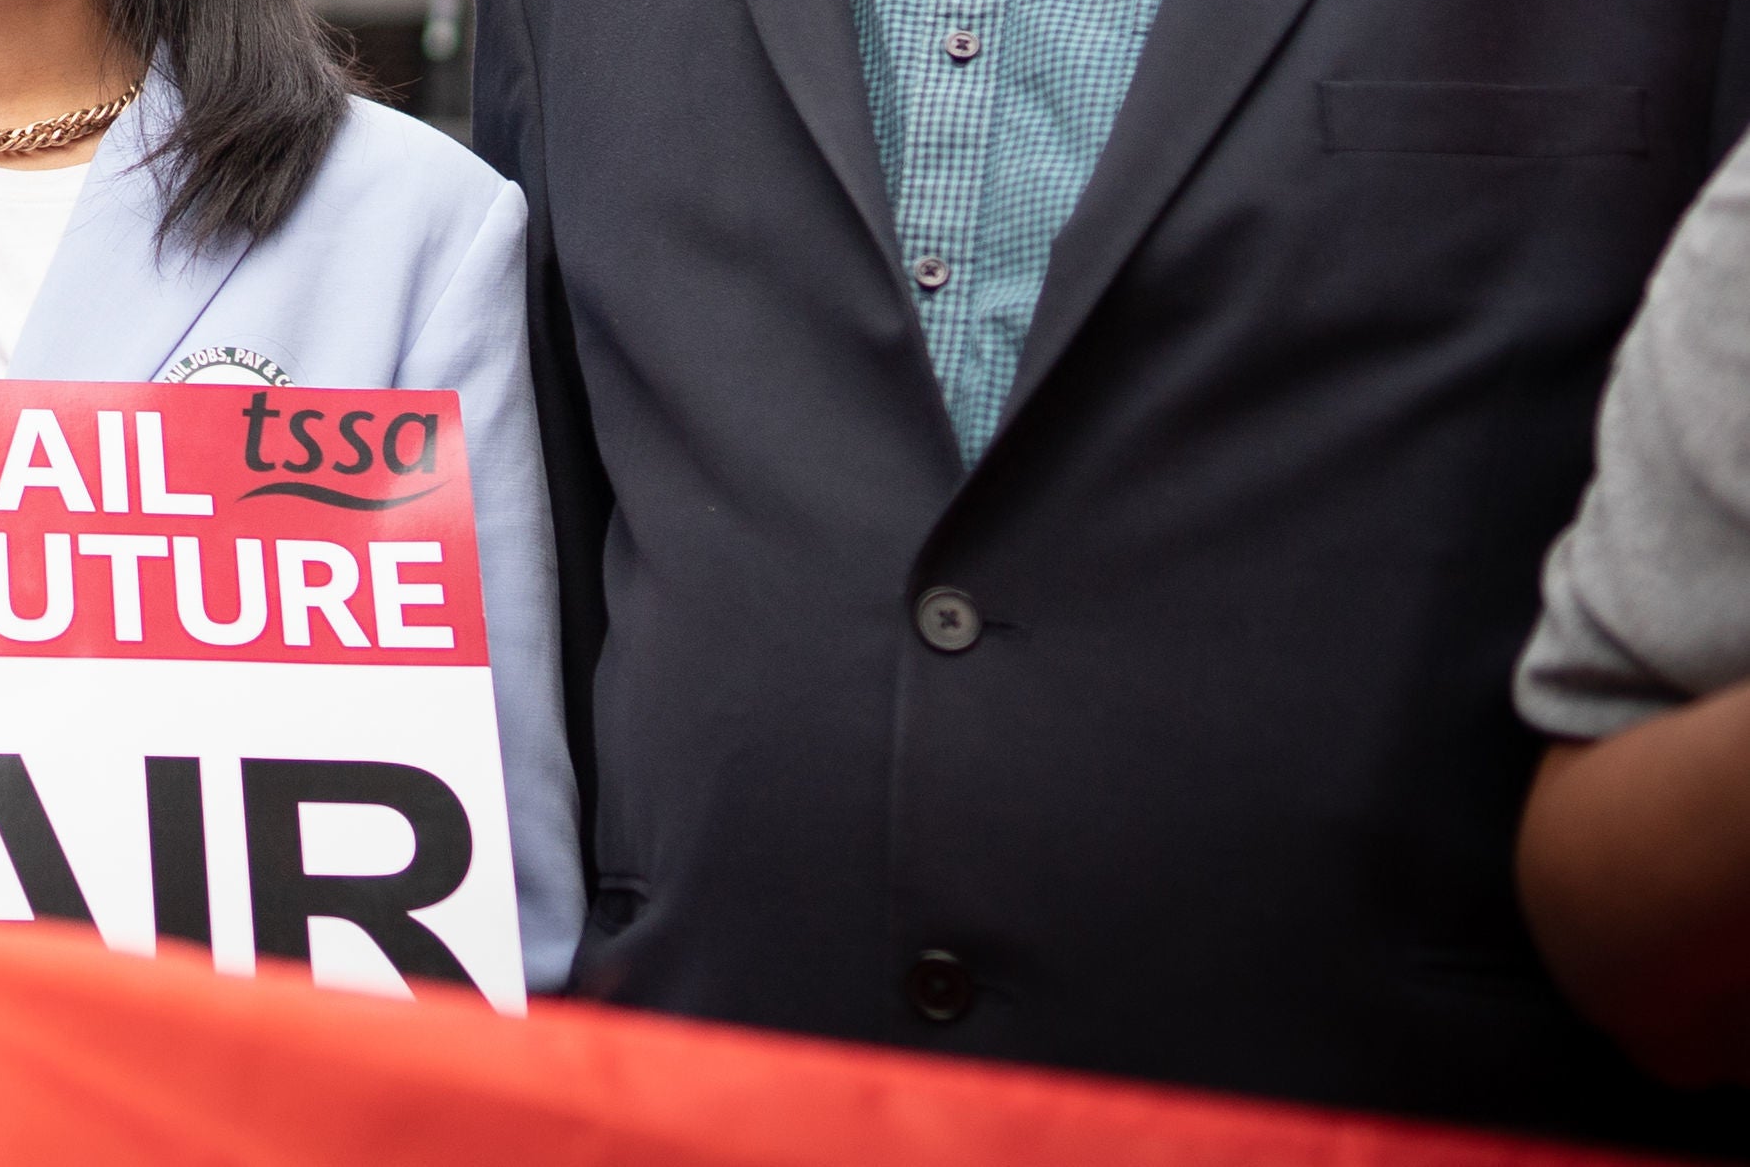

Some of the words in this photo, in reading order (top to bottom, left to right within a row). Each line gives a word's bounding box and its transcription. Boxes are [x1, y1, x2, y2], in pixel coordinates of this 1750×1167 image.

[164, 361, 192, 383] AIL
[188, 346, 232, 370] JOBS,
[233, 347, 266, 370] PAY
[262, 361, 278, 380] &
[242, 390, 439, 476] tssa
